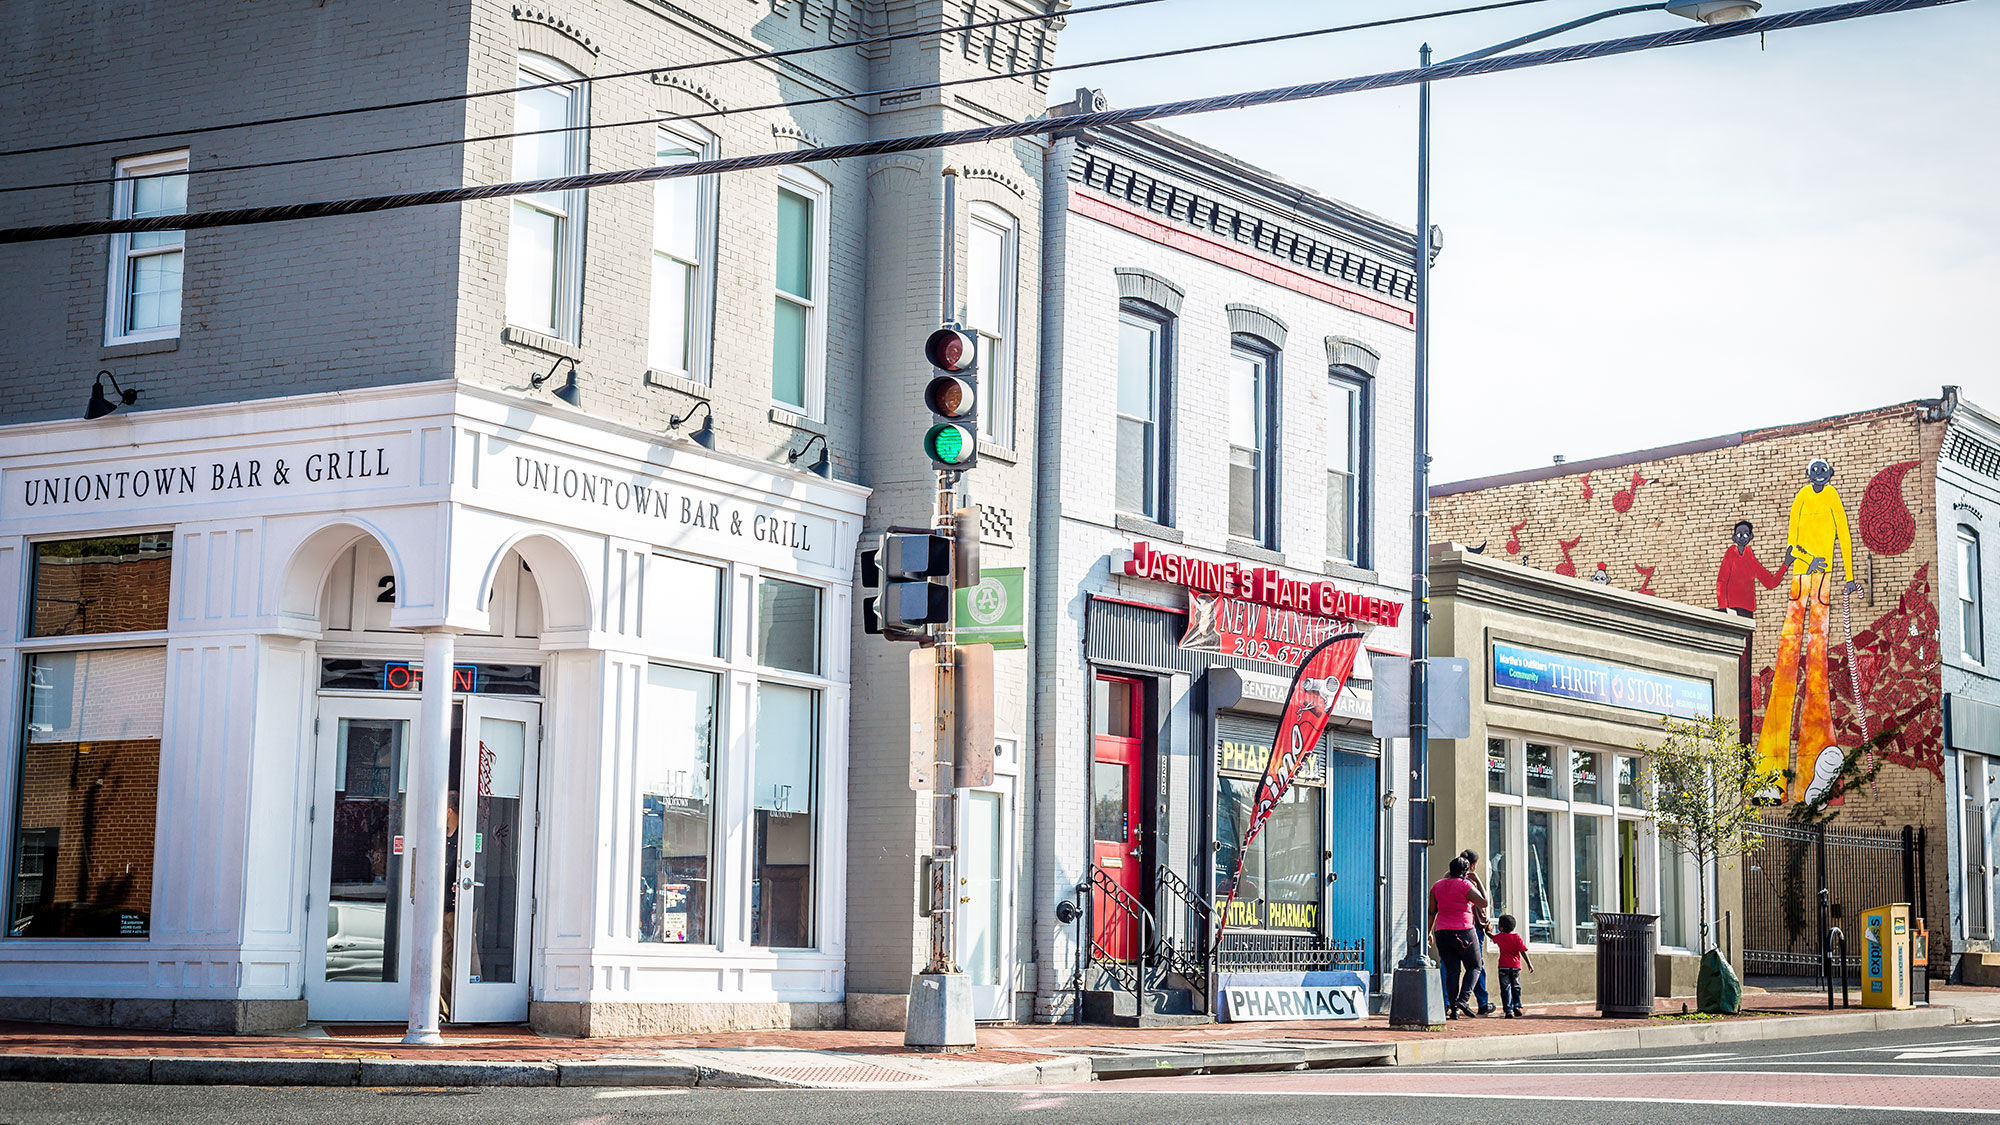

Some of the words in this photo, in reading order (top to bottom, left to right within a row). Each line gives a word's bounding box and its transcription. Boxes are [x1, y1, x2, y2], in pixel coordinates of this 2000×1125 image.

[24, 465, 197, 506] UNIONTOWN
[211, 459, 262, 492] BAR
[273, 458, 290, 486] &
[305, 447, 391, 483] GRILL
[515, 456, 670, 520] UNIONTOWN
[680, 496, 720, 532] BAR
[730, 509, 743, 537] &
[753, 513, 812, 552] GRILL
[1128, 541, 1255, 599] JASMINE'S
[1260, 567, 1312, 612] HAIR
[1319, 580, 1404, 628] GALLERY
[1219, 598, 1261, 639] NEW
[388, 667, 472, 691] OPN
[1243, 681, 1290, 700] CENTRA
[1508, 667, 1539, 684] Community
[1548, 662, 1608, 698] THRIFT
[1627, 677, 1674, 708] STORE
[1269, 902, 1317, 928] PHARMACY
[1231, 990, 1357, 1017] PHARMACY
